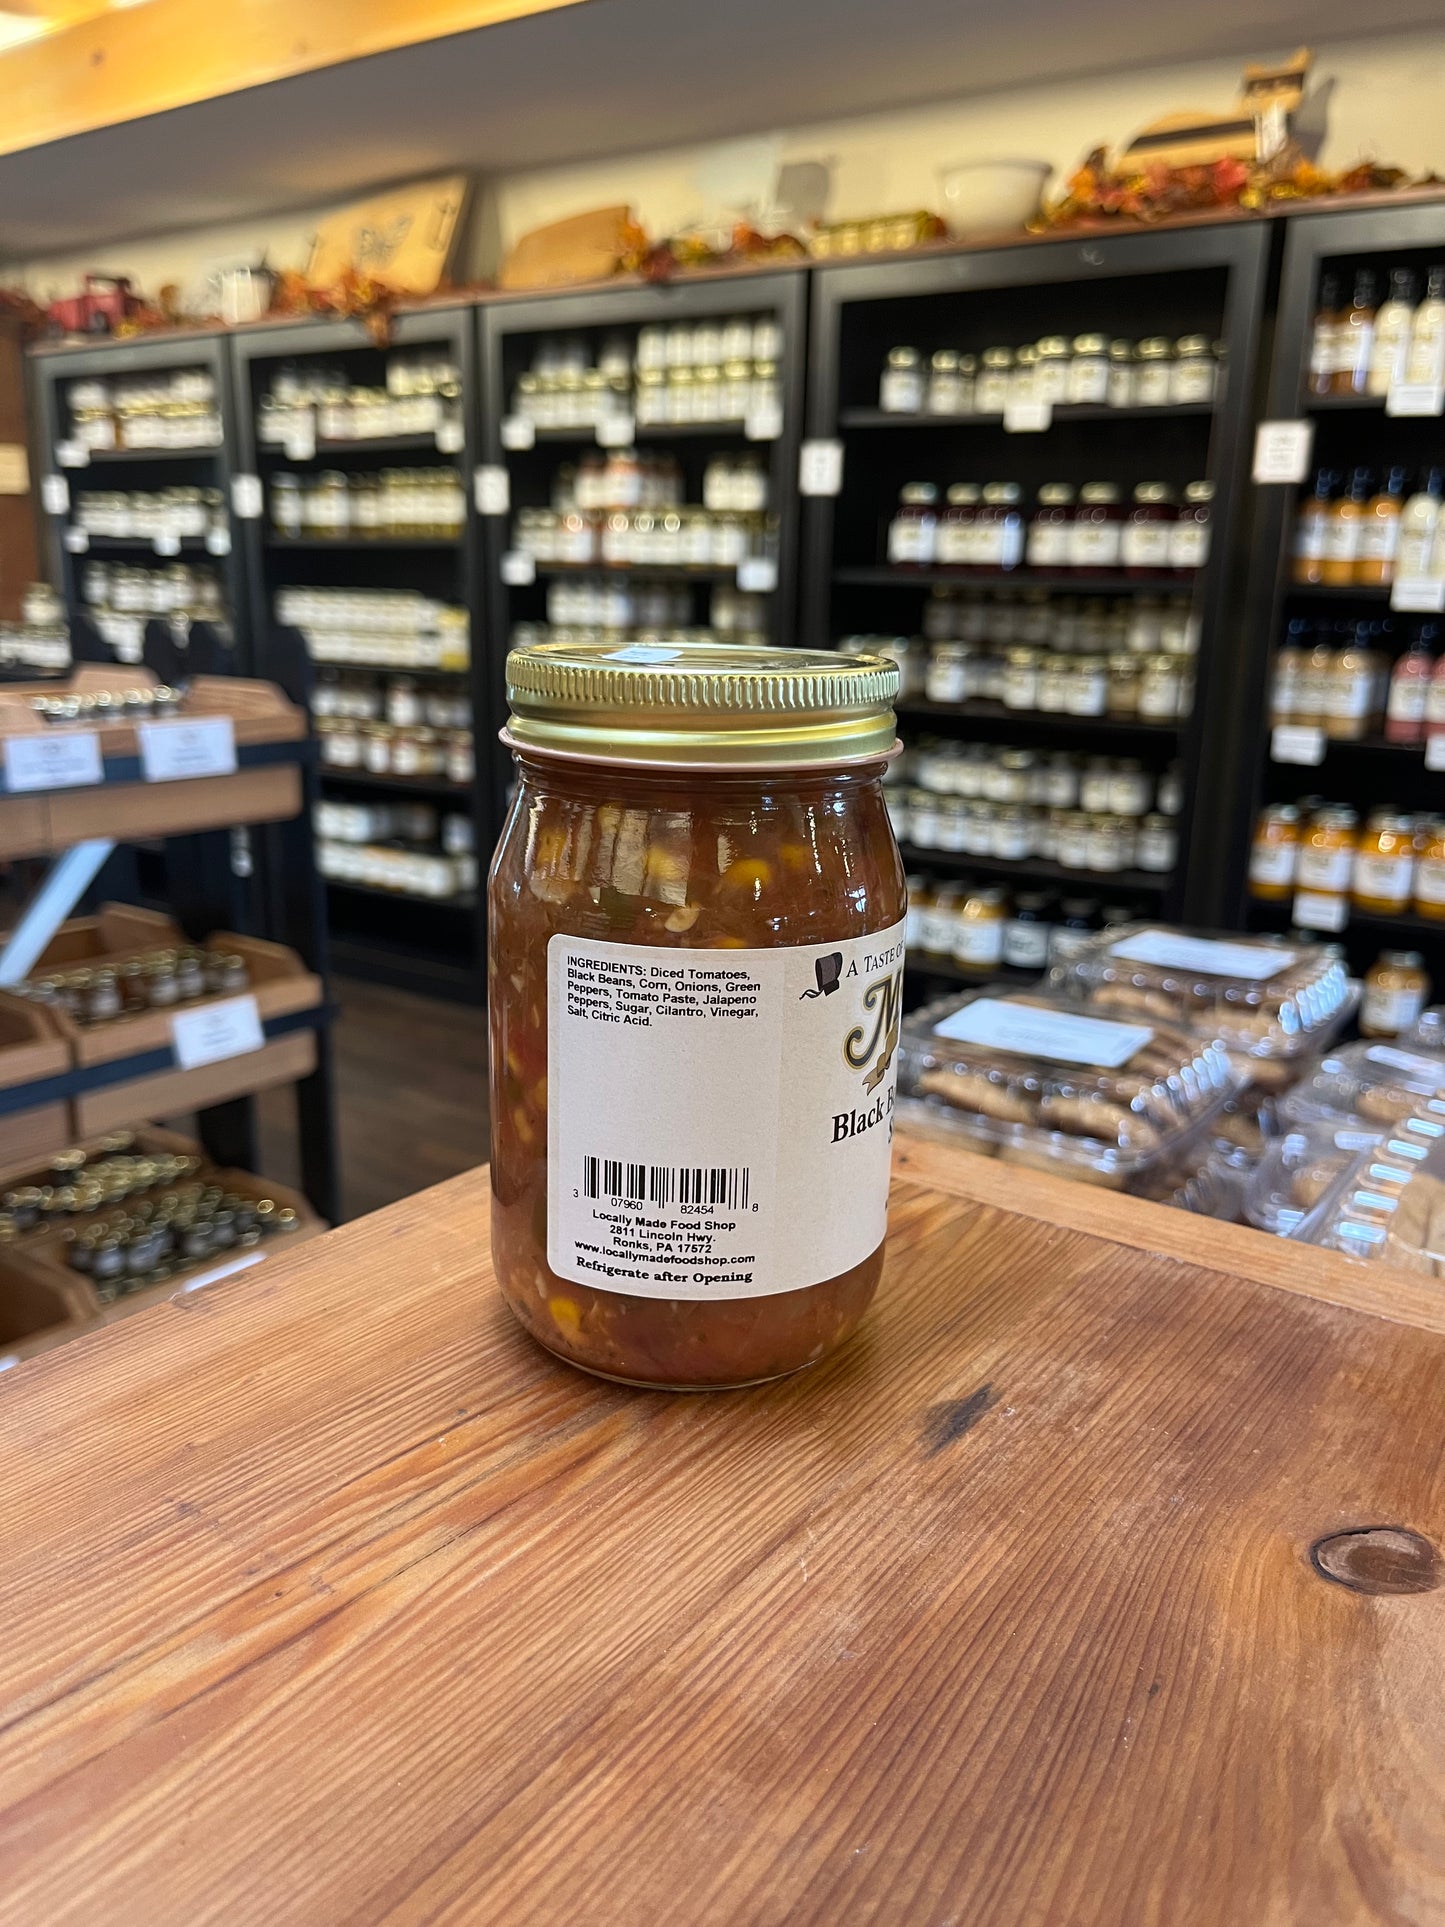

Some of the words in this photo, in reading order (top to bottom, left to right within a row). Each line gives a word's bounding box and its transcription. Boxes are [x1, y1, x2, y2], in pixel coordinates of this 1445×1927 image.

[567, 956, 647, 976] INGREDIENTS:
[650, 967, 684, 978] Diced
[688, 969, 750, 980] Tomatoes,
[846, 960, 859, 978] A
[567, 969, 595, 981] Black
[599, 974, 635, 989] Beans,
[639, 979, 671, 991] Corn,
[675, 981, 721, 993] Onions,
[725, 982, 760, 992] Green
[567, 981, 612, 998] Peppers,
[616, 989, 659, 1002] Tomato
[662, 994, 699, 1005] Paste,
[702, 994, 756, 1006] Jalapeno
[567, 993, 612, 1010] Peppers,
[615, 1001, 652, 1015] Sugar,
[655, 1005, 706, 1018] Cilantro,
[710, 1007, 758, 1019] Vinegar,
[567, 1005, 589, 1019] Salt,
[592, 1010, 620, 1023] Citric
[623, 1015, 652, 1026] Acid.
[831, 1097, 885, 1143] Black
[573, 1189, 579, 1198] 3
[592, 1209, 632, 1226] Locally
[635, 1217, 667, 1228] Made
[670, 1220, 700, 1230] Food
[705, 1221, 736, 1231] Shop
[610, 1225, 634, 1237] 2811
[639, 1230, 683, 1241] Lincoln
[687, 1233, 716, 1244] Hwy.
[613, 1237, 652, 1251] Ronks,
[656, 1242, 673, 1252] PA
[677, 1244, 712, 1253] 17572
[574, 1241, 755, 1266] www.locallymadefoodshop.com
[577, 1256, 649, 1279] Refrigerate
[654, 1272, 688, 1282] after
[693, 1272, 753, 1285] Opening
